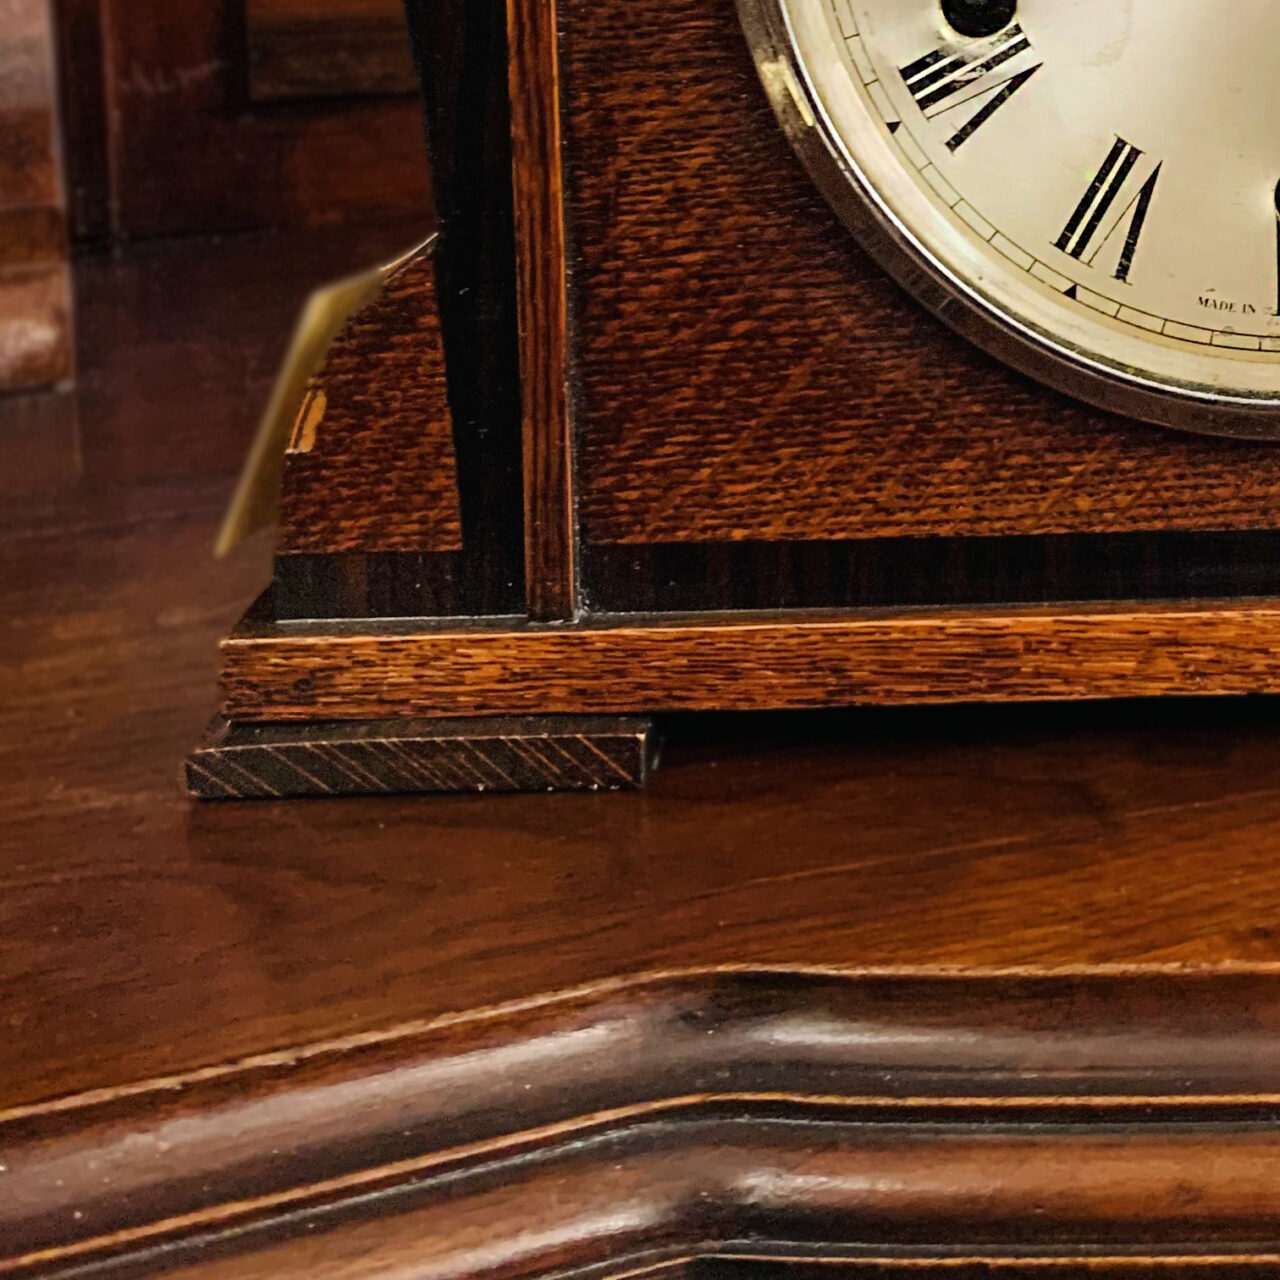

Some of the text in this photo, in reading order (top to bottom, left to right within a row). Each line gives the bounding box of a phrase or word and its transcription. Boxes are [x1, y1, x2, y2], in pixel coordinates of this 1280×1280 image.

[899, 20, 1044, 154] VIII
[1050, 134, 1163, 286] VII
[1198, 296, 1236, 312] MADE
[1242, 303, 1257, 314] IN
